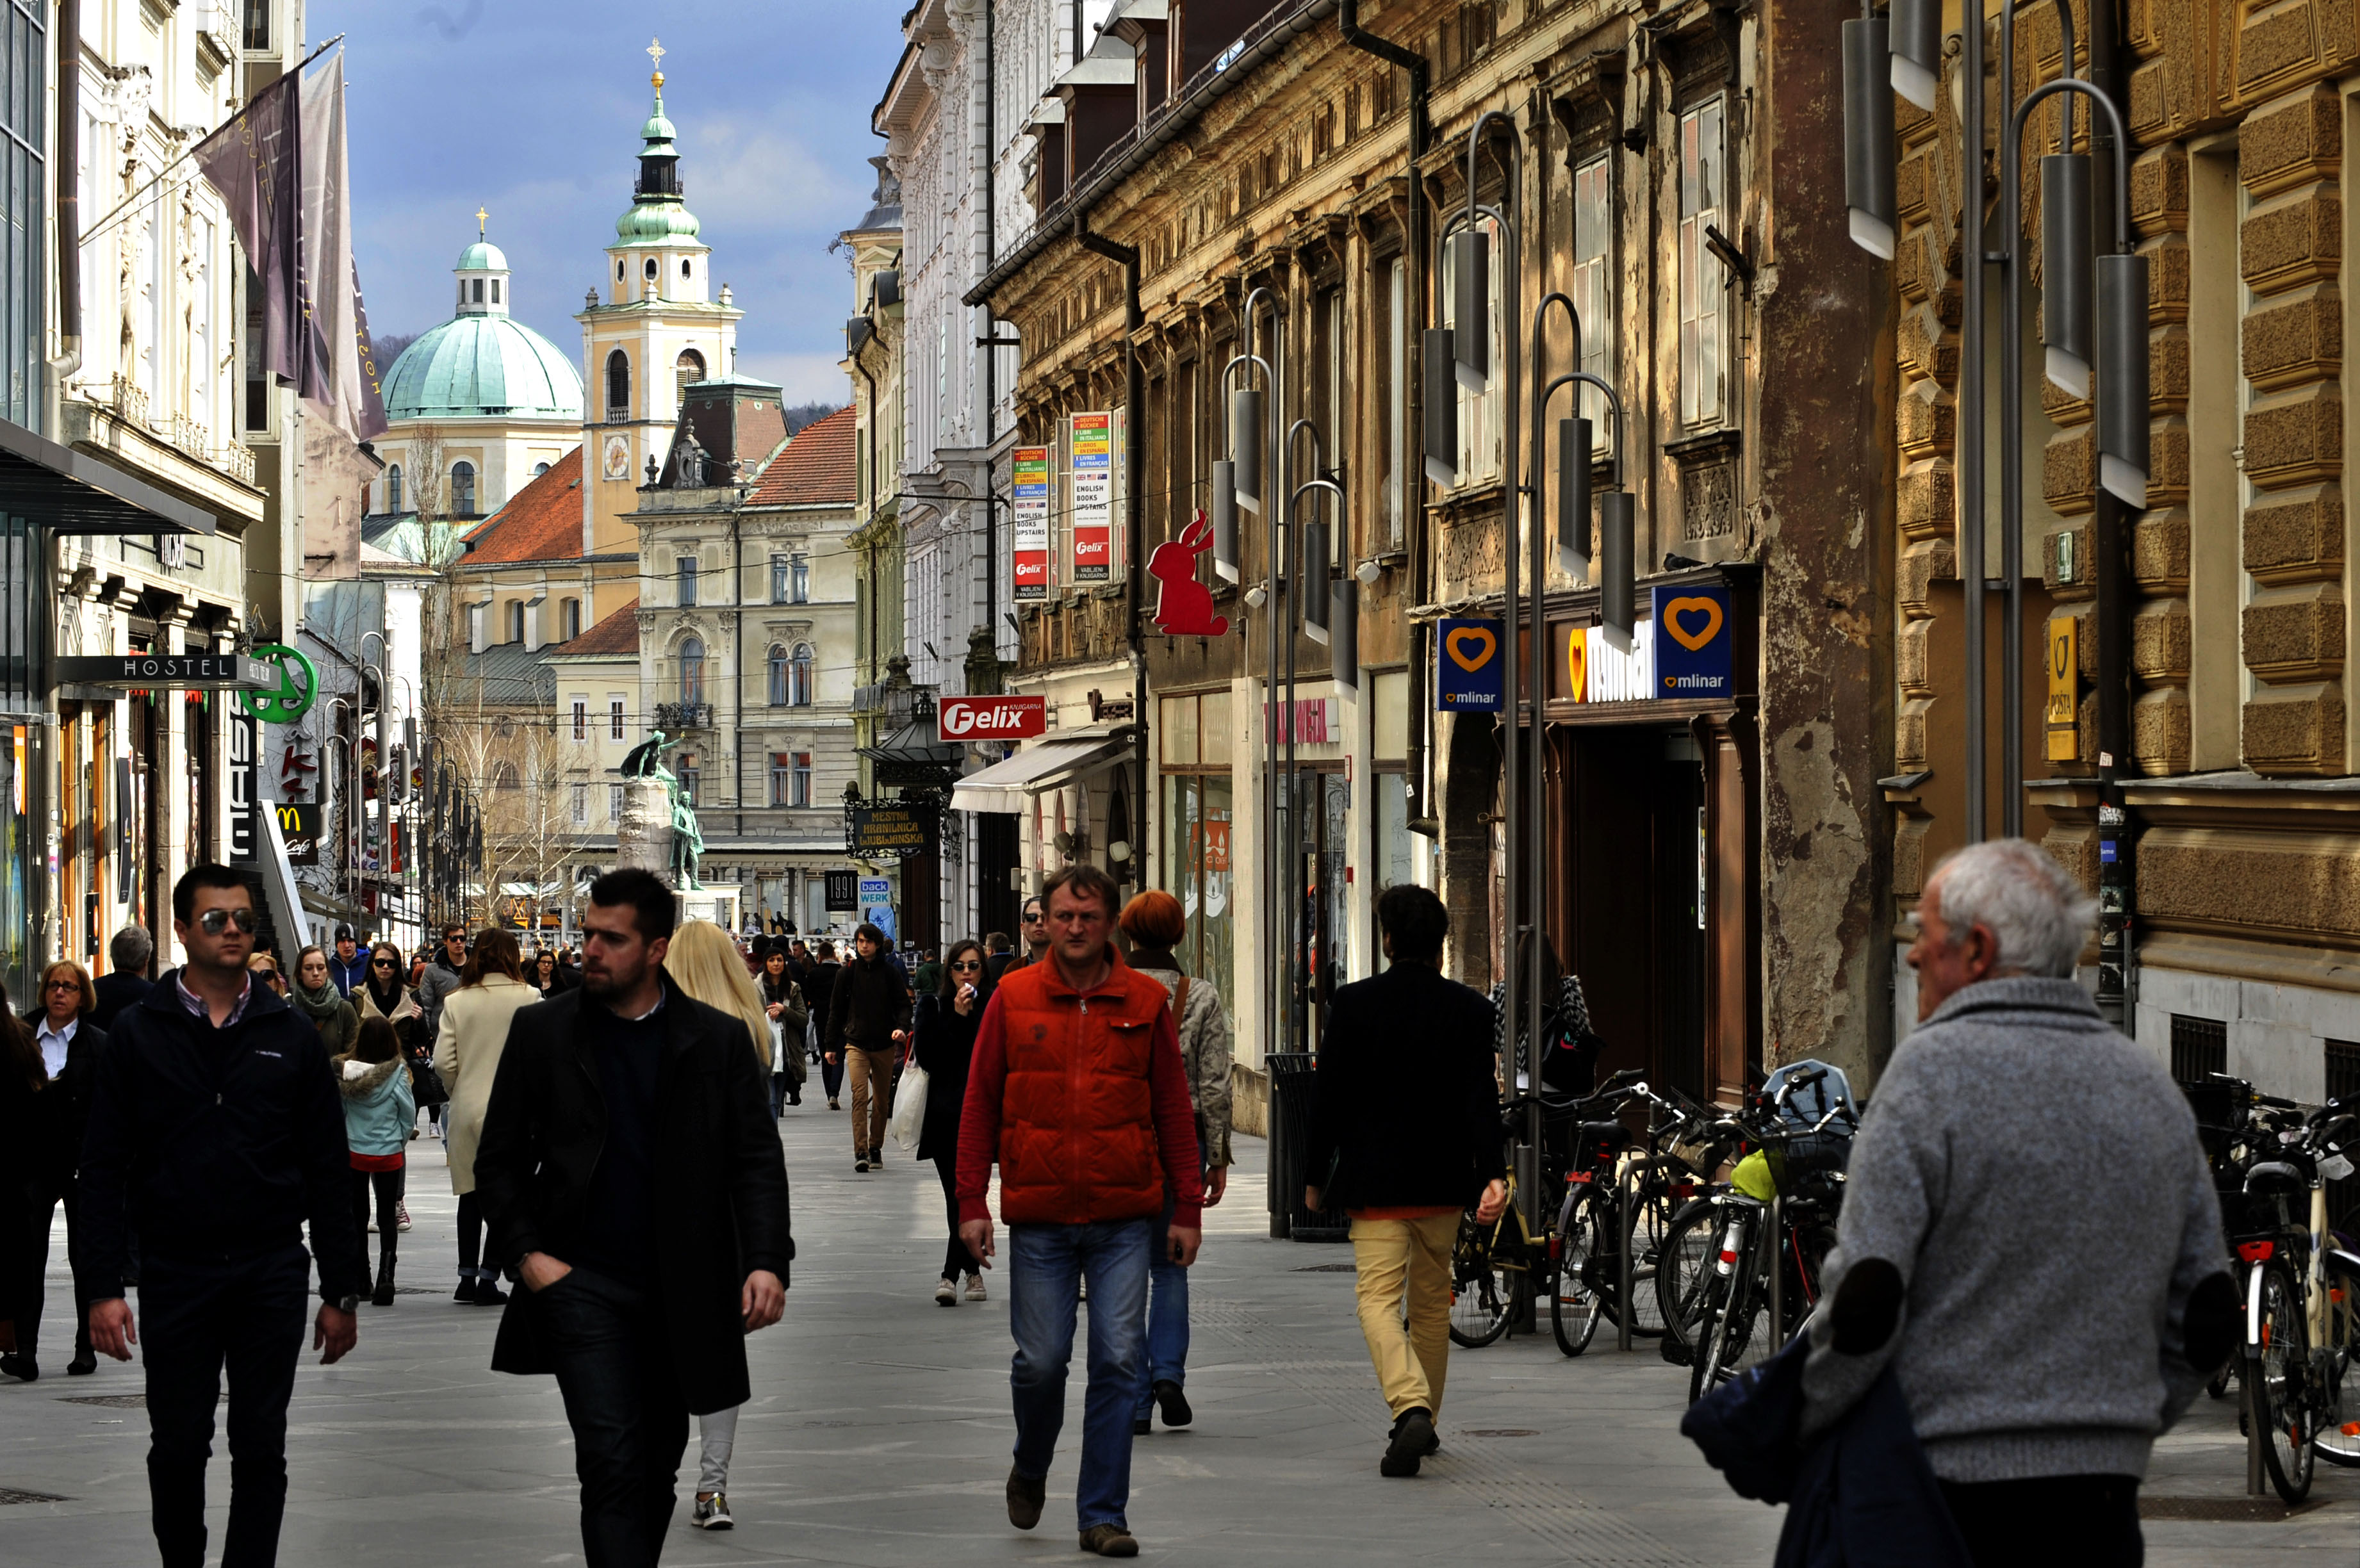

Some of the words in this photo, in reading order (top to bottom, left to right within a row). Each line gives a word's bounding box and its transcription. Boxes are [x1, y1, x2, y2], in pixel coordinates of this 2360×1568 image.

[1076, 541, 1102, 555] Felix
[1016, 564, 1041, 576] Felix
[124, 660, 228, 676] HOSTEL
[1678, 674, 1724, 688] mlinar
[1457, 691, 1496, 703] mlinar
[2051, 690, 2071, 715] POŠTA
[944, 703, 1024, 735] Felix
[871, 811, 910, 822] MESTNA
[863, 822, 919, 834] HRANILNICA
[859, 833, 924, 845] LJUBLJANSKA
[830, 876, 853, 899] 1991
[862, 882, 887, 892] back
[861, 894, 889, 902] WERK
